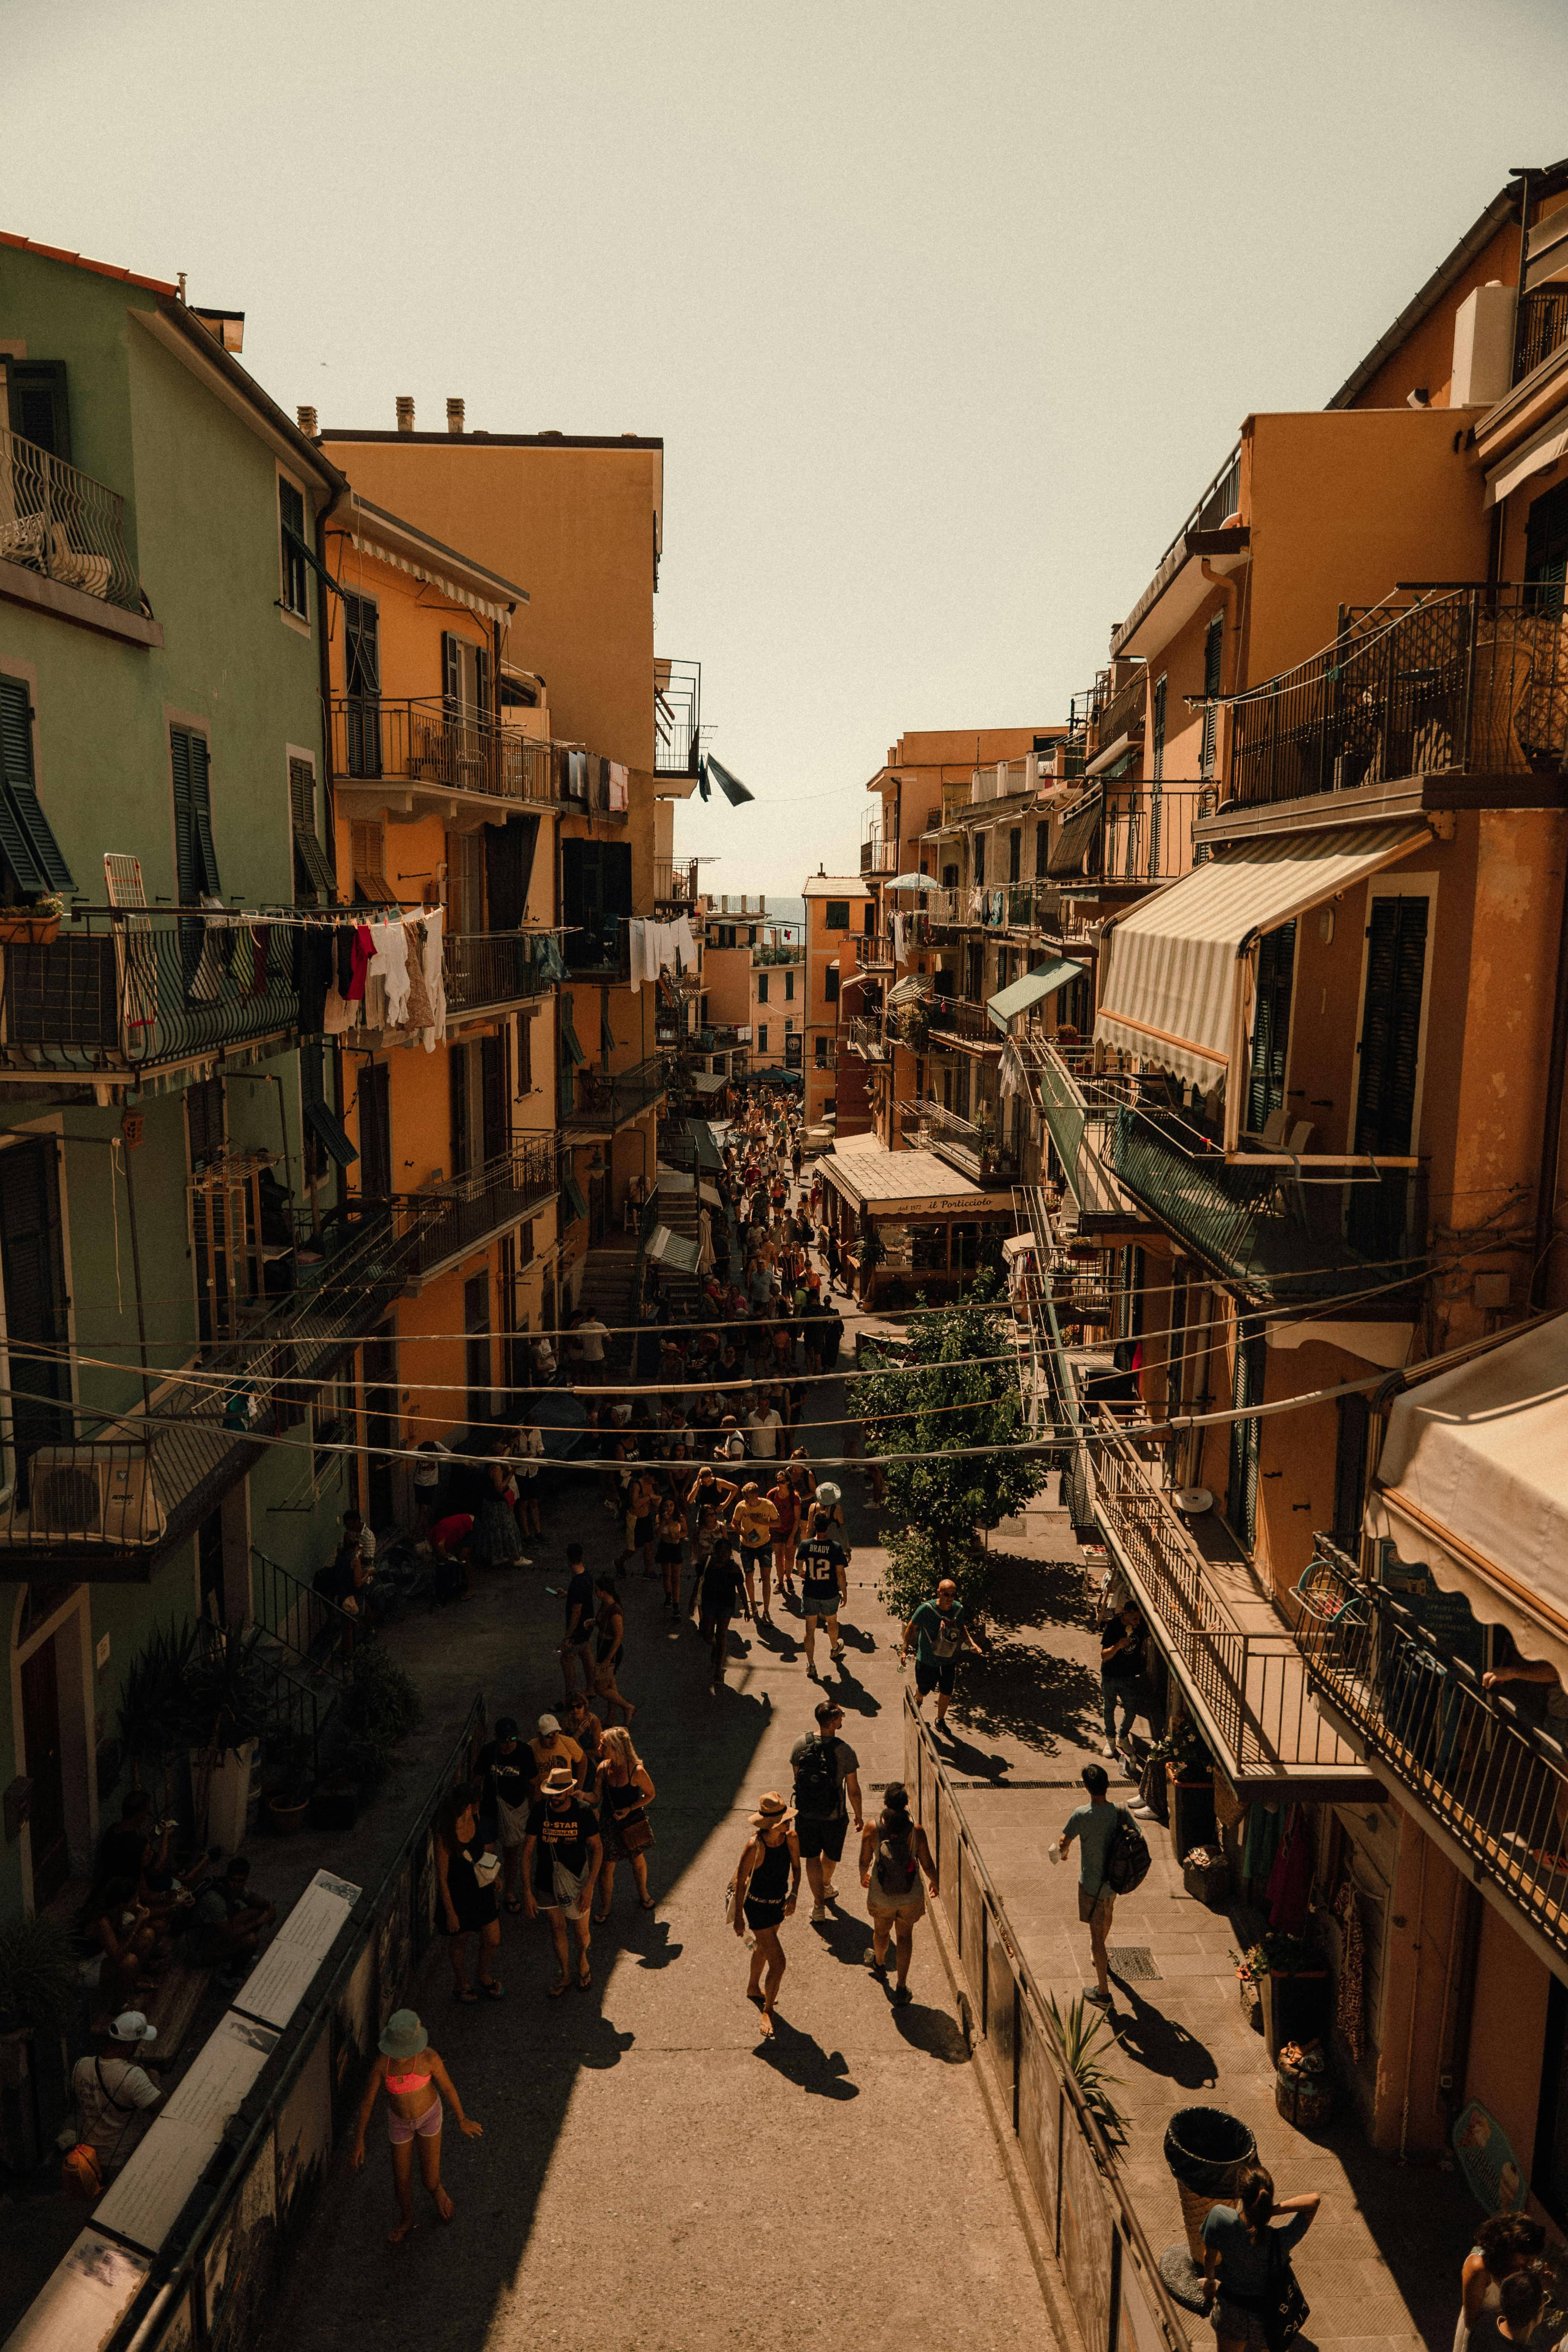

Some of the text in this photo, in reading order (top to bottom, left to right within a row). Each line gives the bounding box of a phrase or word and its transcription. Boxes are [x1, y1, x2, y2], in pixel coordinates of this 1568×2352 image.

[927, 1201, 938, 1209] il
[940, 1198, 993, 1209] Porticciolo
[809, 1544, 830, 1555] BRADY
[807, 1557, 830, 1581] 12
